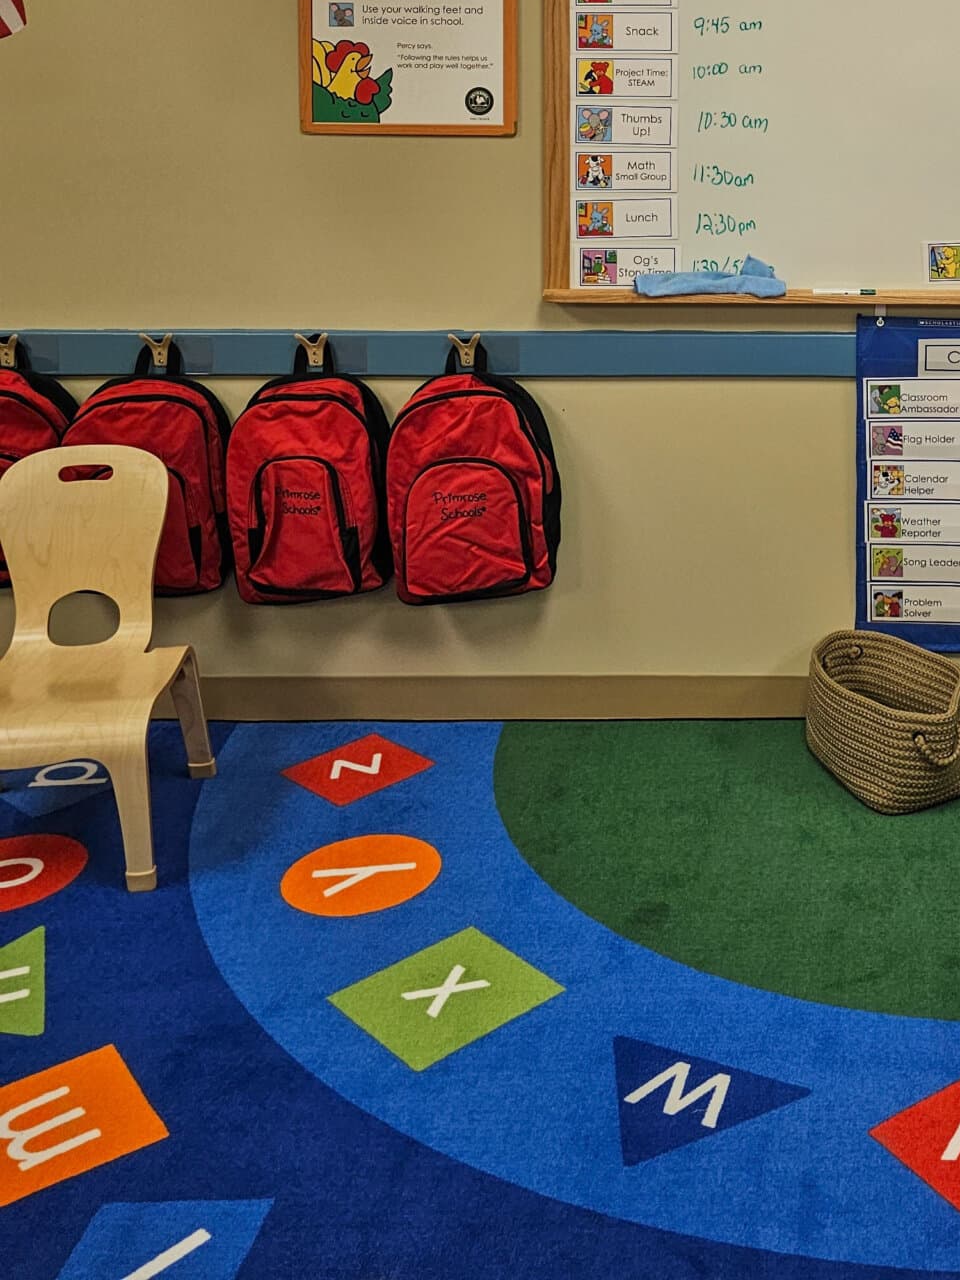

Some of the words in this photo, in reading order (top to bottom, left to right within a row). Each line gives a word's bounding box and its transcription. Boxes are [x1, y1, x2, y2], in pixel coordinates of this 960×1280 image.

[362, 5, 379, 14] Use
[381, 7, 402, 16] your
[404, 6, 440, 16] walking
[442, 6, 462, 15] feet
[464, 6, 484, 15] and
[362, 17, 389, 25] inside
[391, 17, 418, 25] voice
[420, 17, 429, 26] in
[430, 17, 464, 26] school.
[694, 16, 730, 36] 9:45
[739, 20, 762, 31] am
[625, 27, 659, 36] Snack
[615, 69, 645, 79] Project
[646, 69, 668, 77] Time:
[692, 62, 729, 79] 10:00
[739, 63, 762, 74] am
[627, 79, 656, 87] STEAM
[621, 114, 663, 124] Thumbs
[697, 111, 737, 133] 10:30
[742, 114, 769, 132] am
[632, 126, 651, 137] Up!
[627, 161, 656, 170] Math
[615, 172, 639, 181] Small
[640, 173, 667, 182] Group
[625, 213, 658, 222] Lunch
[633, 255, 659, 267] Og's
[900, 393, 948, 402] Classroom
[900, 404, 959, 413] Ambassador
[903, 434, 922, 445] Flag
[925, 434, 955, 443] Holder
[904, 475, 949, 483] Calendar
[904, 486, 934, 496] Helper
[432, 492, 487, 504] Primrose
[901, 517, 941, 526] Weather
[901, 529, 941, 539] Reporter
[903, 558, 927, 568] Song
[904, 598, 942, 607] Problem
[904, 609, 932, 618] Solver
